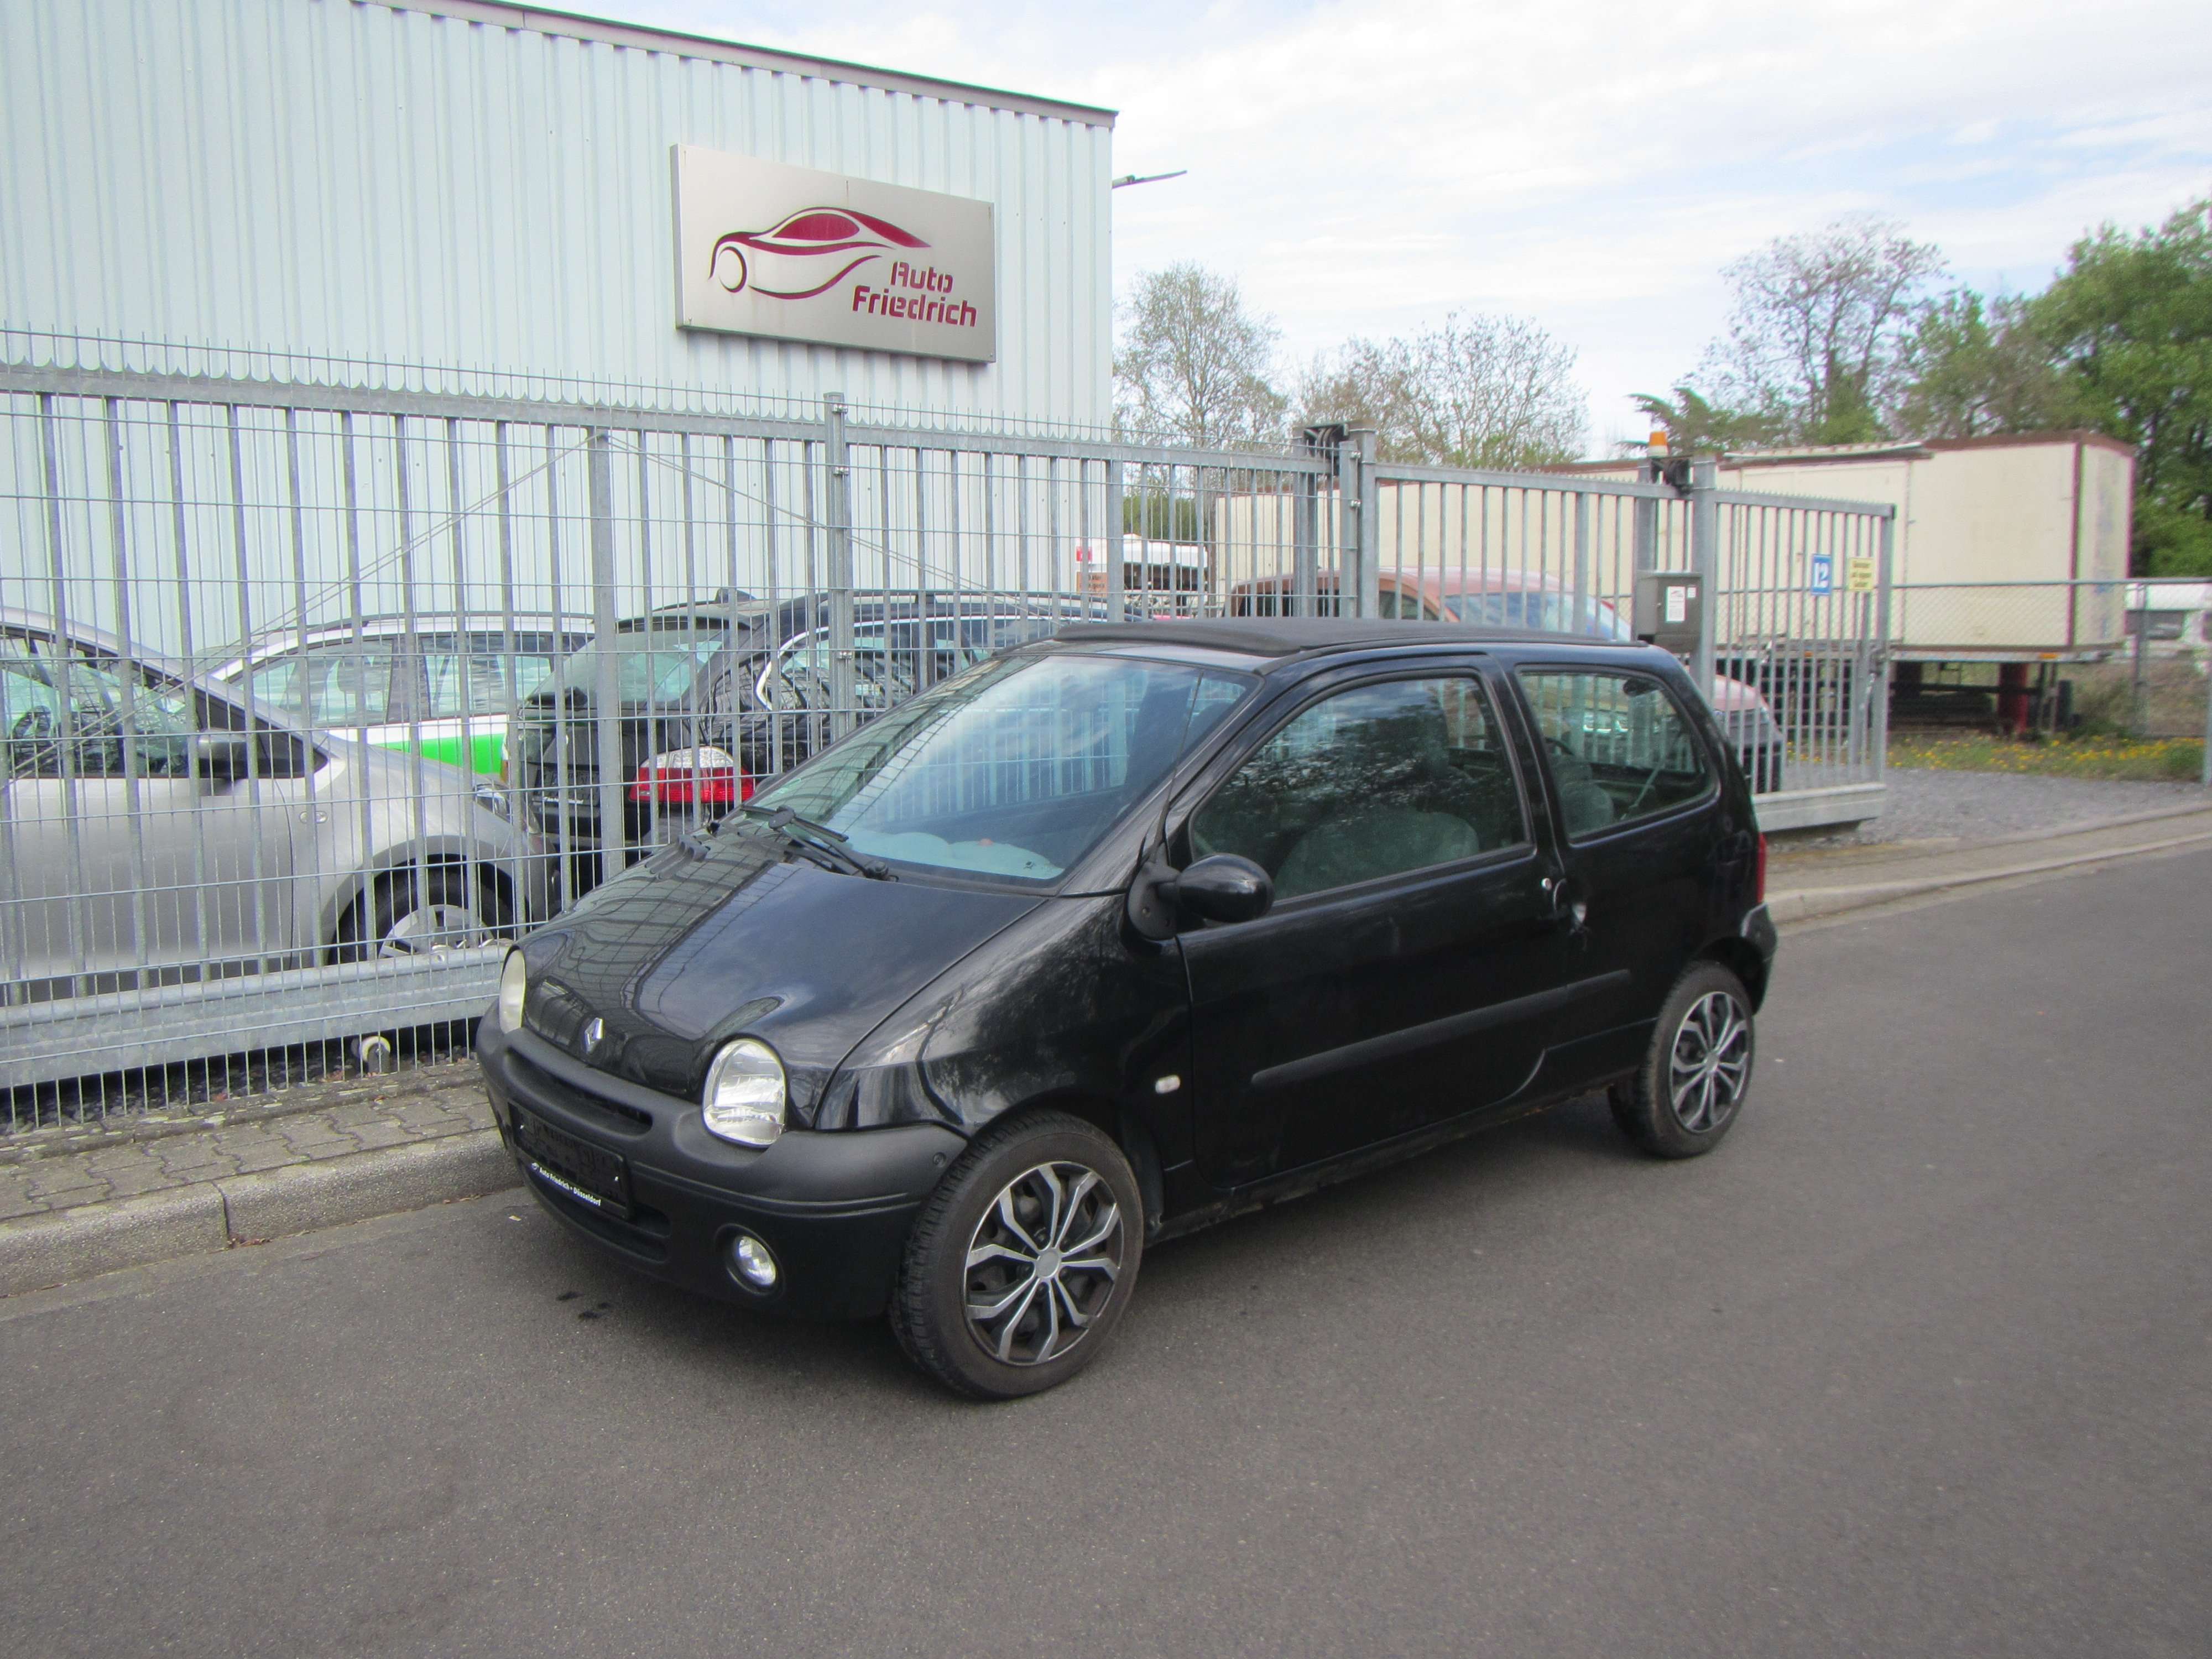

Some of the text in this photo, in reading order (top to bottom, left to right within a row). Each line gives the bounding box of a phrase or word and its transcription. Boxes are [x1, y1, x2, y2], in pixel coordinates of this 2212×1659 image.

[890, 261, 953, 294] Auto
[852, 285, 977, 327] Friedrich
[573, 1186, 602, 1207] Düsseldorf
